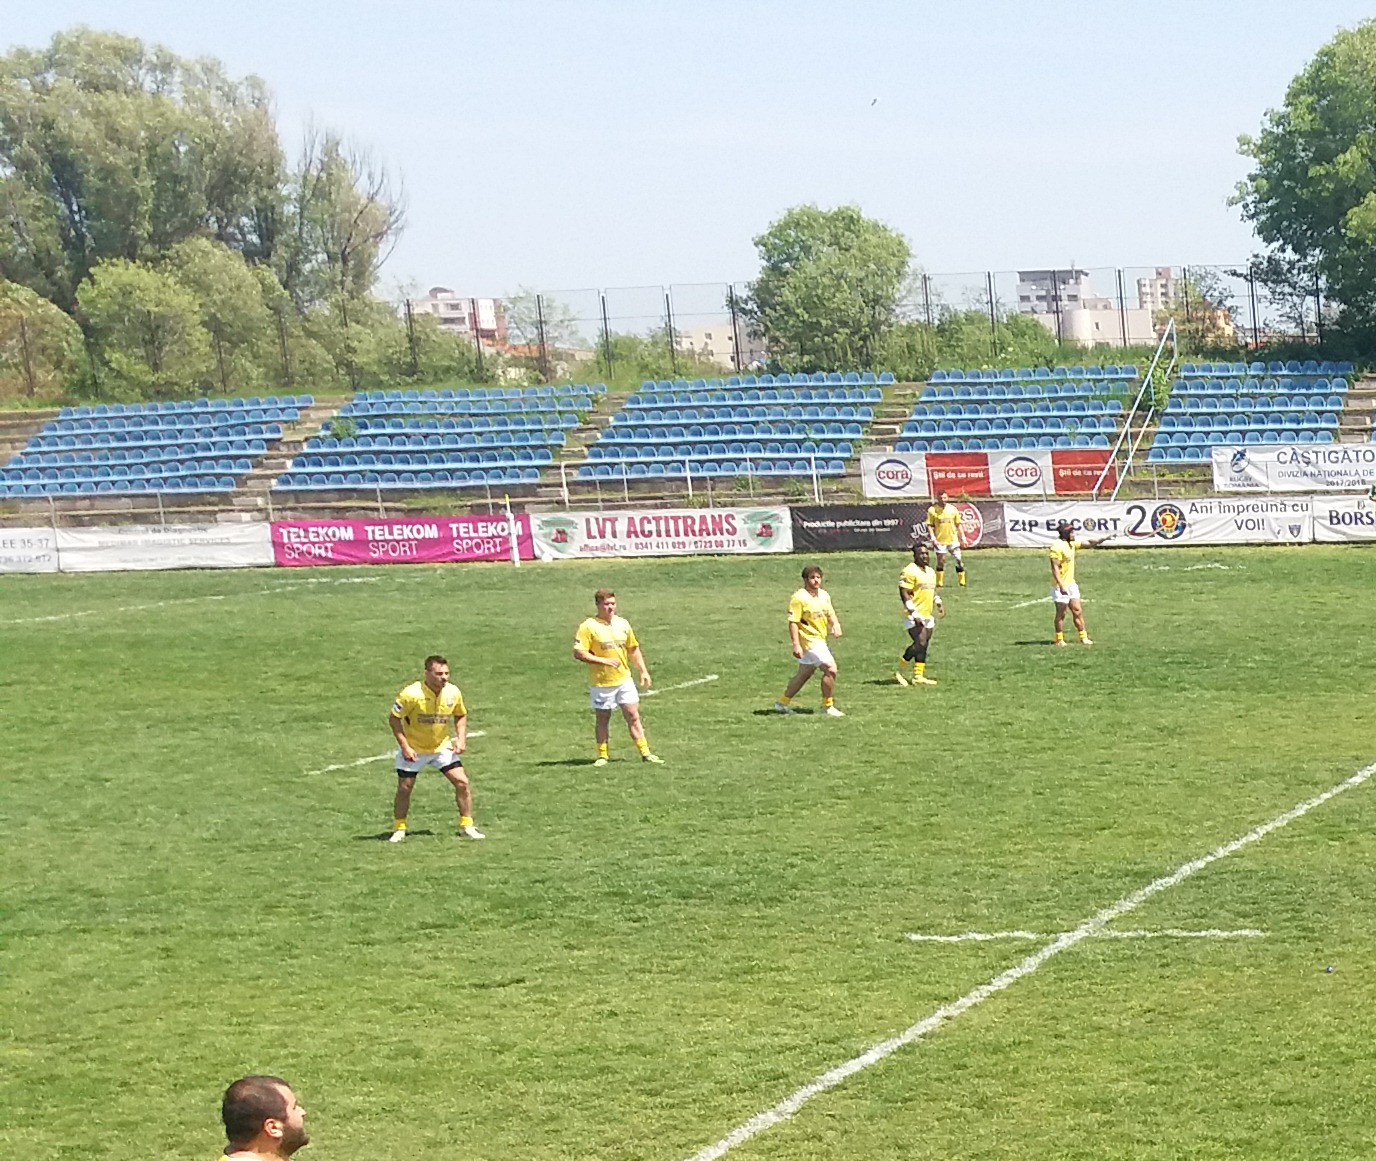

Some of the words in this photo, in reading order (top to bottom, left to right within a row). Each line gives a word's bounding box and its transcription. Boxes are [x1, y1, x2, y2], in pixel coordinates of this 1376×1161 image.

[877, 469, 909, 480] cora
[1006, 466, 1039, 478] cora
[1189, 501, 1213, 514] Ani
[1291, 502, 1308, 512] cu
[364, 522, 439, 540] TELEKOM
[585, 516, 618, 540] LVT
[626, 513, 738, 539] ACTITRANS
[1009, 518, 1039, 532] ZIP
[1234, 518, 1265, 531] VOI!
[280, 525, 354, 544] TELEKOM
[285, 543, 334, 559] SPORT
[369, 540, 418, 557] SPORT
[453, 537, 502, 555] SPORT
